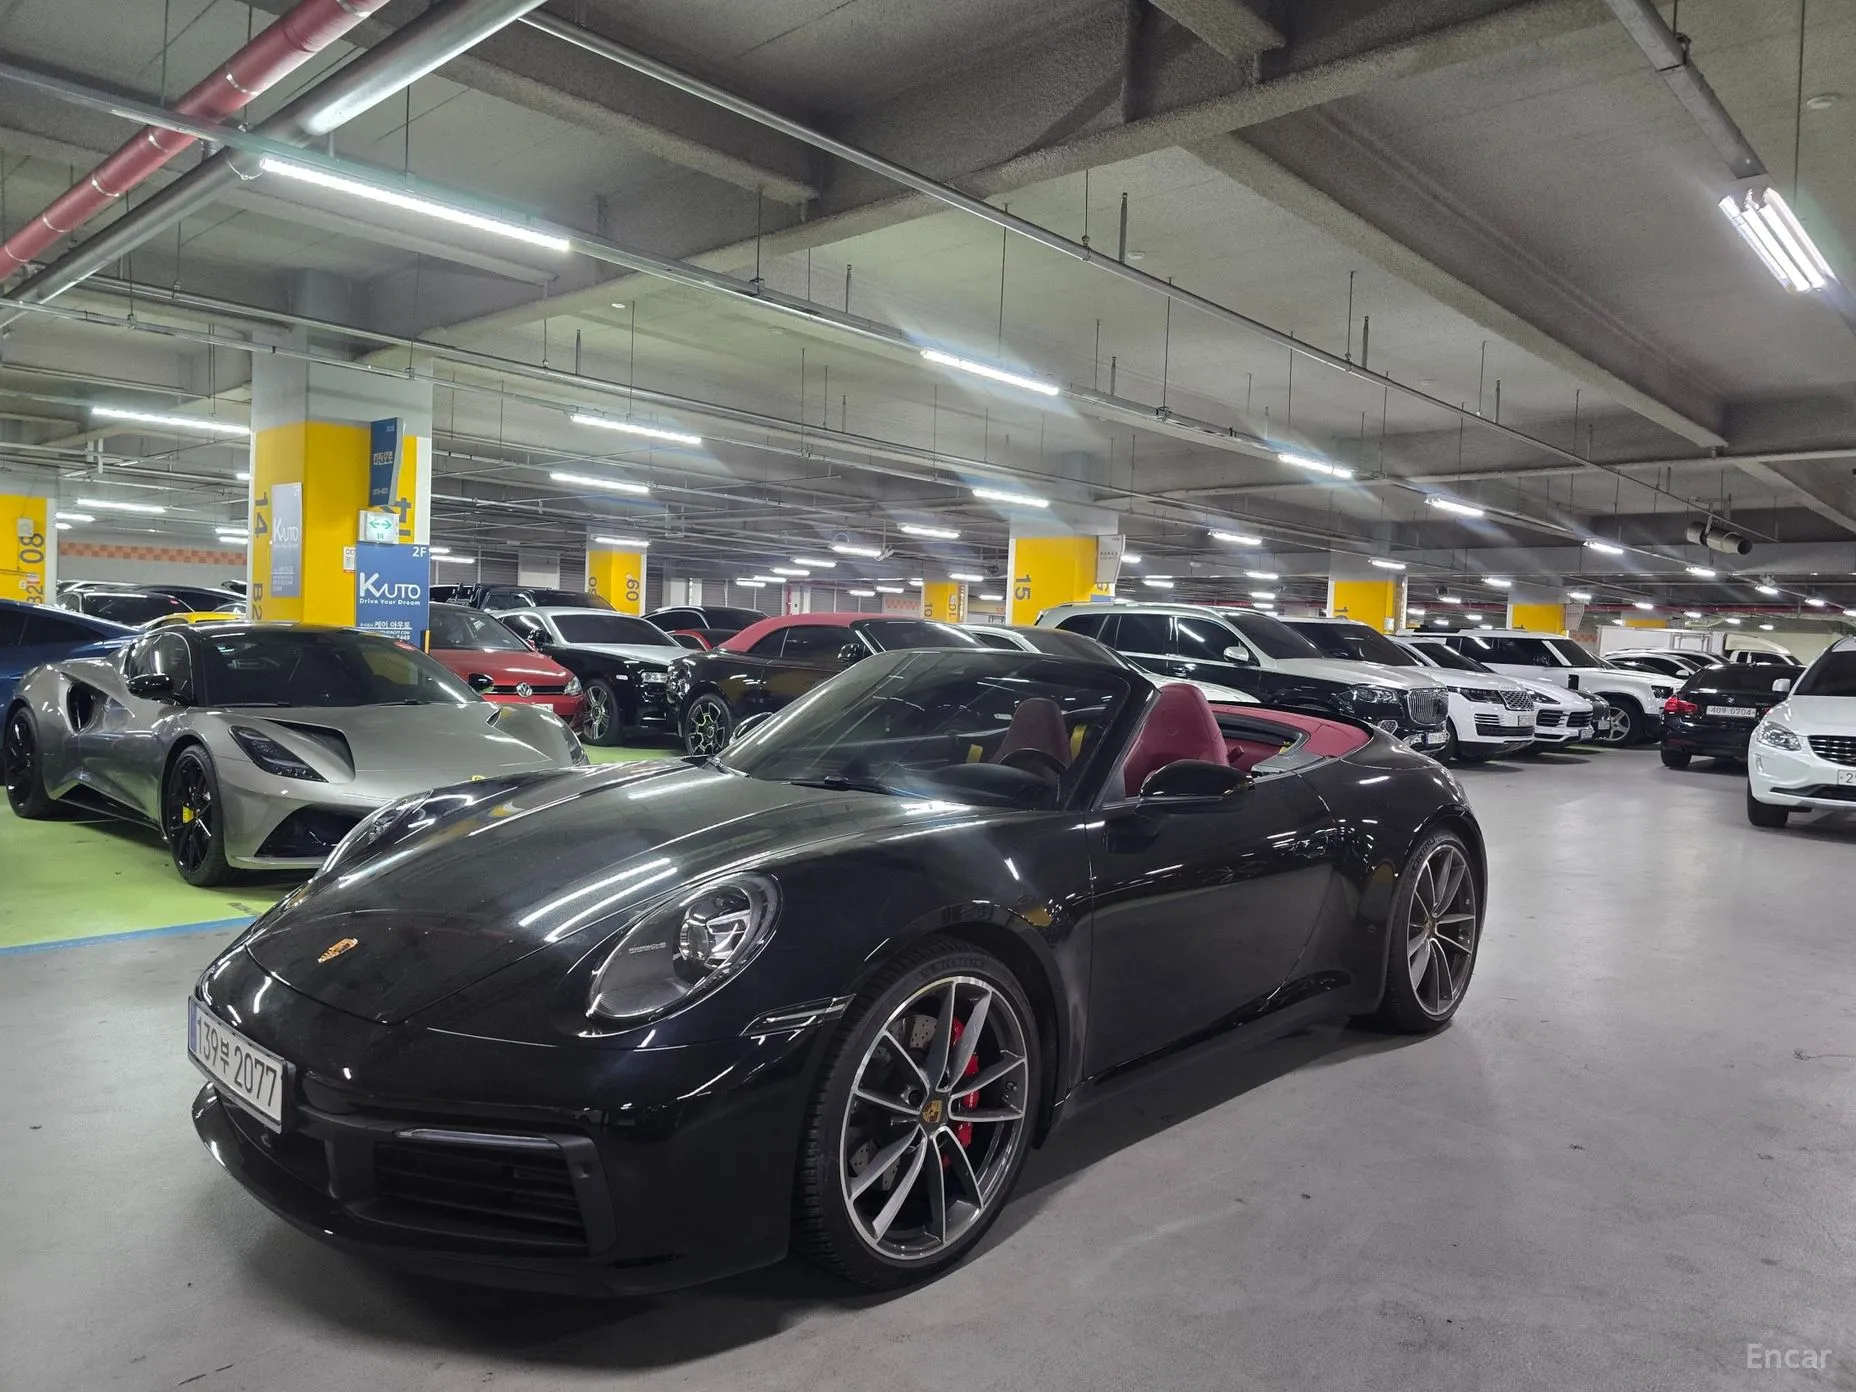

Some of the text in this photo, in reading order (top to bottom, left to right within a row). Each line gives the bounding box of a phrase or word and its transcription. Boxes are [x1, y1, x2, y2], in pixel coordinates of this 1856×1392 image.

[255, 491, 269, 538] 14
[412, 546, 427, 557] 2F
[1015, 574, 1032, 601] 15
[197, 1016, 278, 1108] 139부 2077
